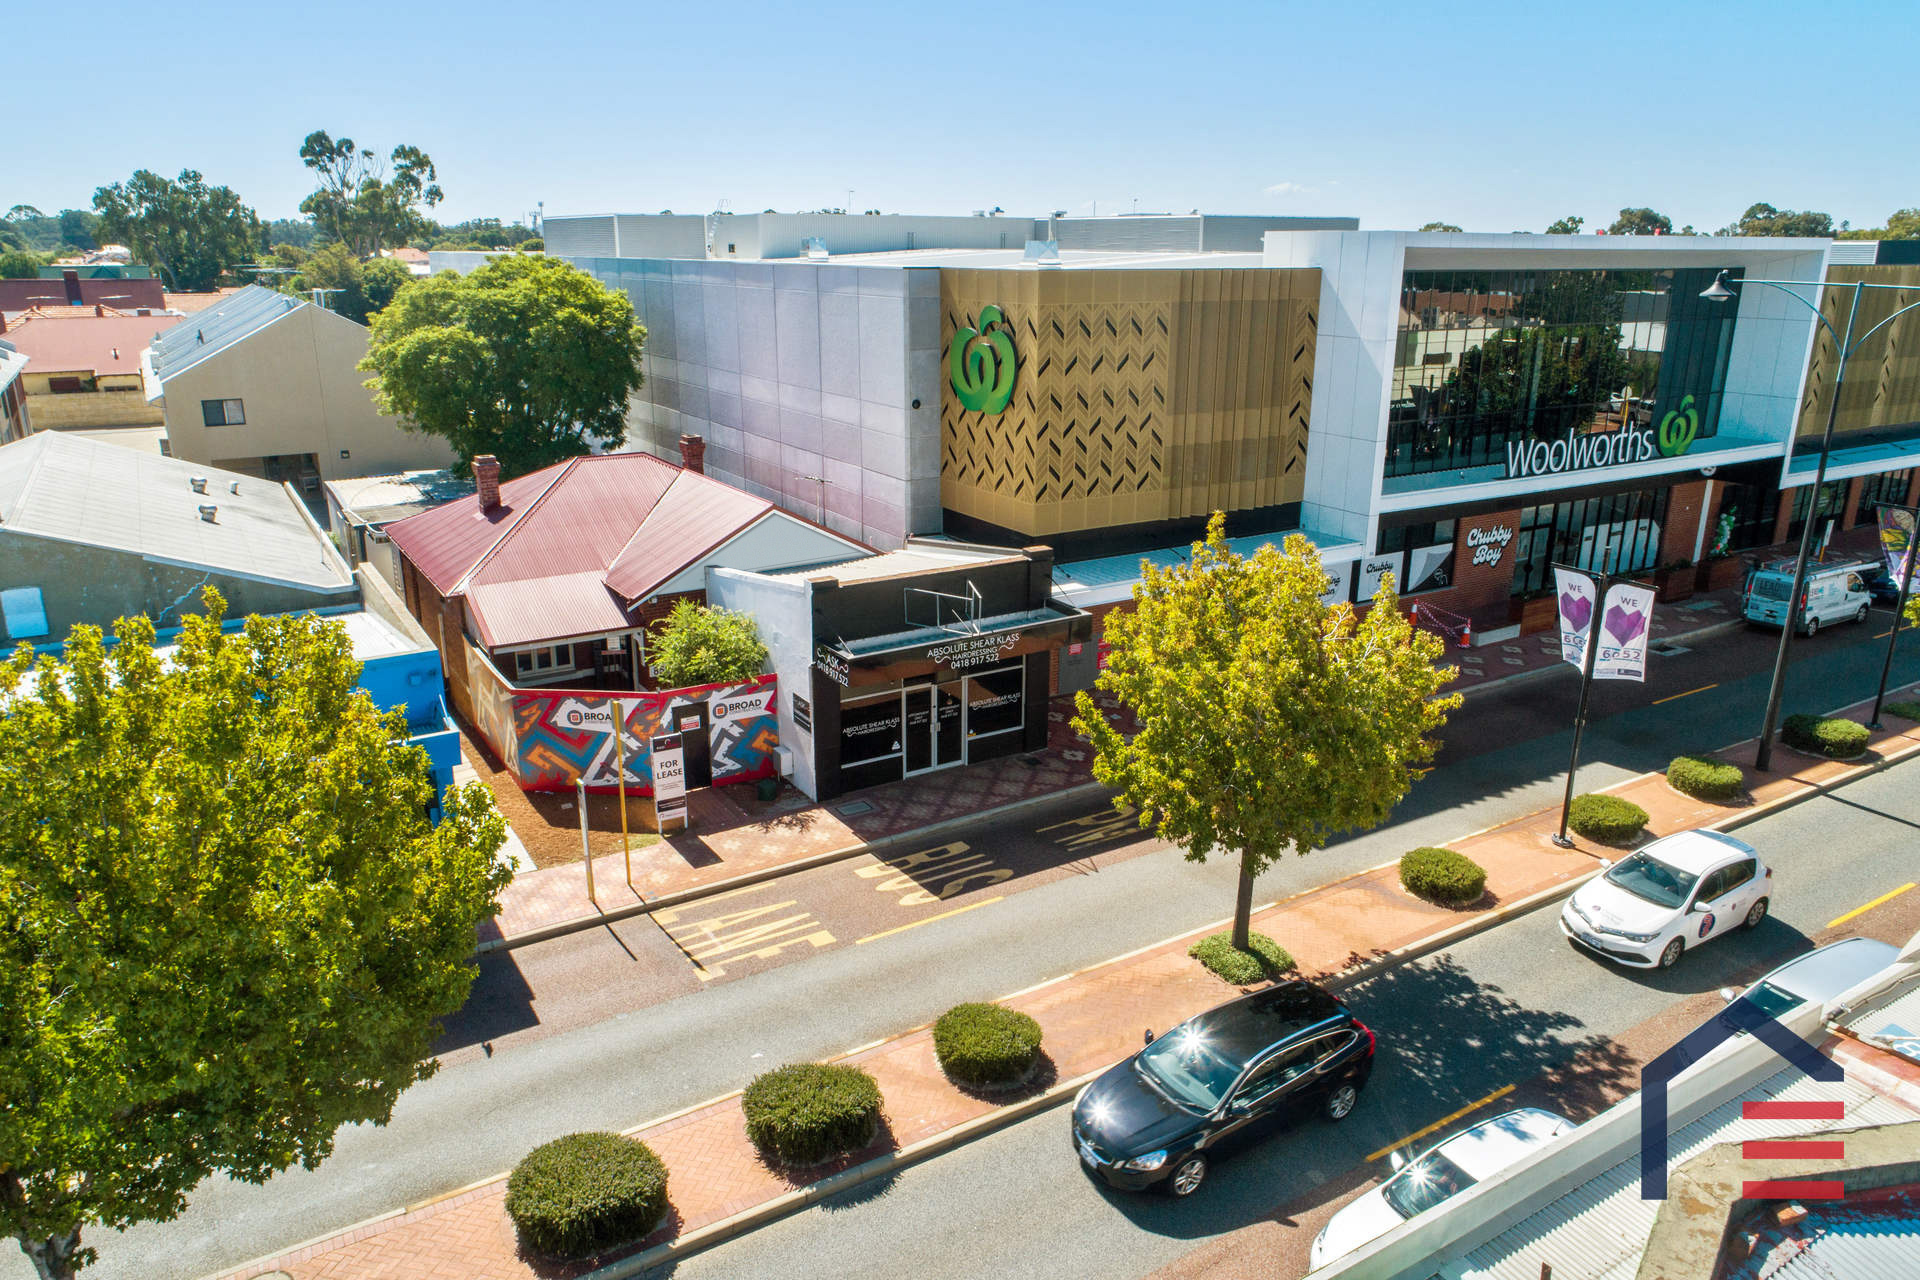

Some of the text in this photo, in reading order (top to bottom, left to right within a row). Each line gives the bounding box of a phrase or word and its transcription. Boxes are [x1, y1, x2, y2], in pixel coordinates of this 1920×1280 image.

[1508, 420, 1653, 478] Woolworths
[1467, 524, 1513, 547] Chubby
[1472, 544, 1503, 567] Boy
[1567, 582, 1582, 593] WE
[1620, 596, 1638, 607] WE
[927, 633, 1020, 658] ABSOLUTE SHEAR KLASS
[952, 647, 998, 660] HAIRDRESSING
[950, 653, 1000, 669] 0418 917 522
[729, 698, 762, 711] BROAD
[584, 712, 612, 721] BROA
[660, 759, 678, 770] FOR
[656, 768, 683, 780] LEASE
[853, 840, 1014, 906] BUS
[647, 881, 837, 983] LANE
